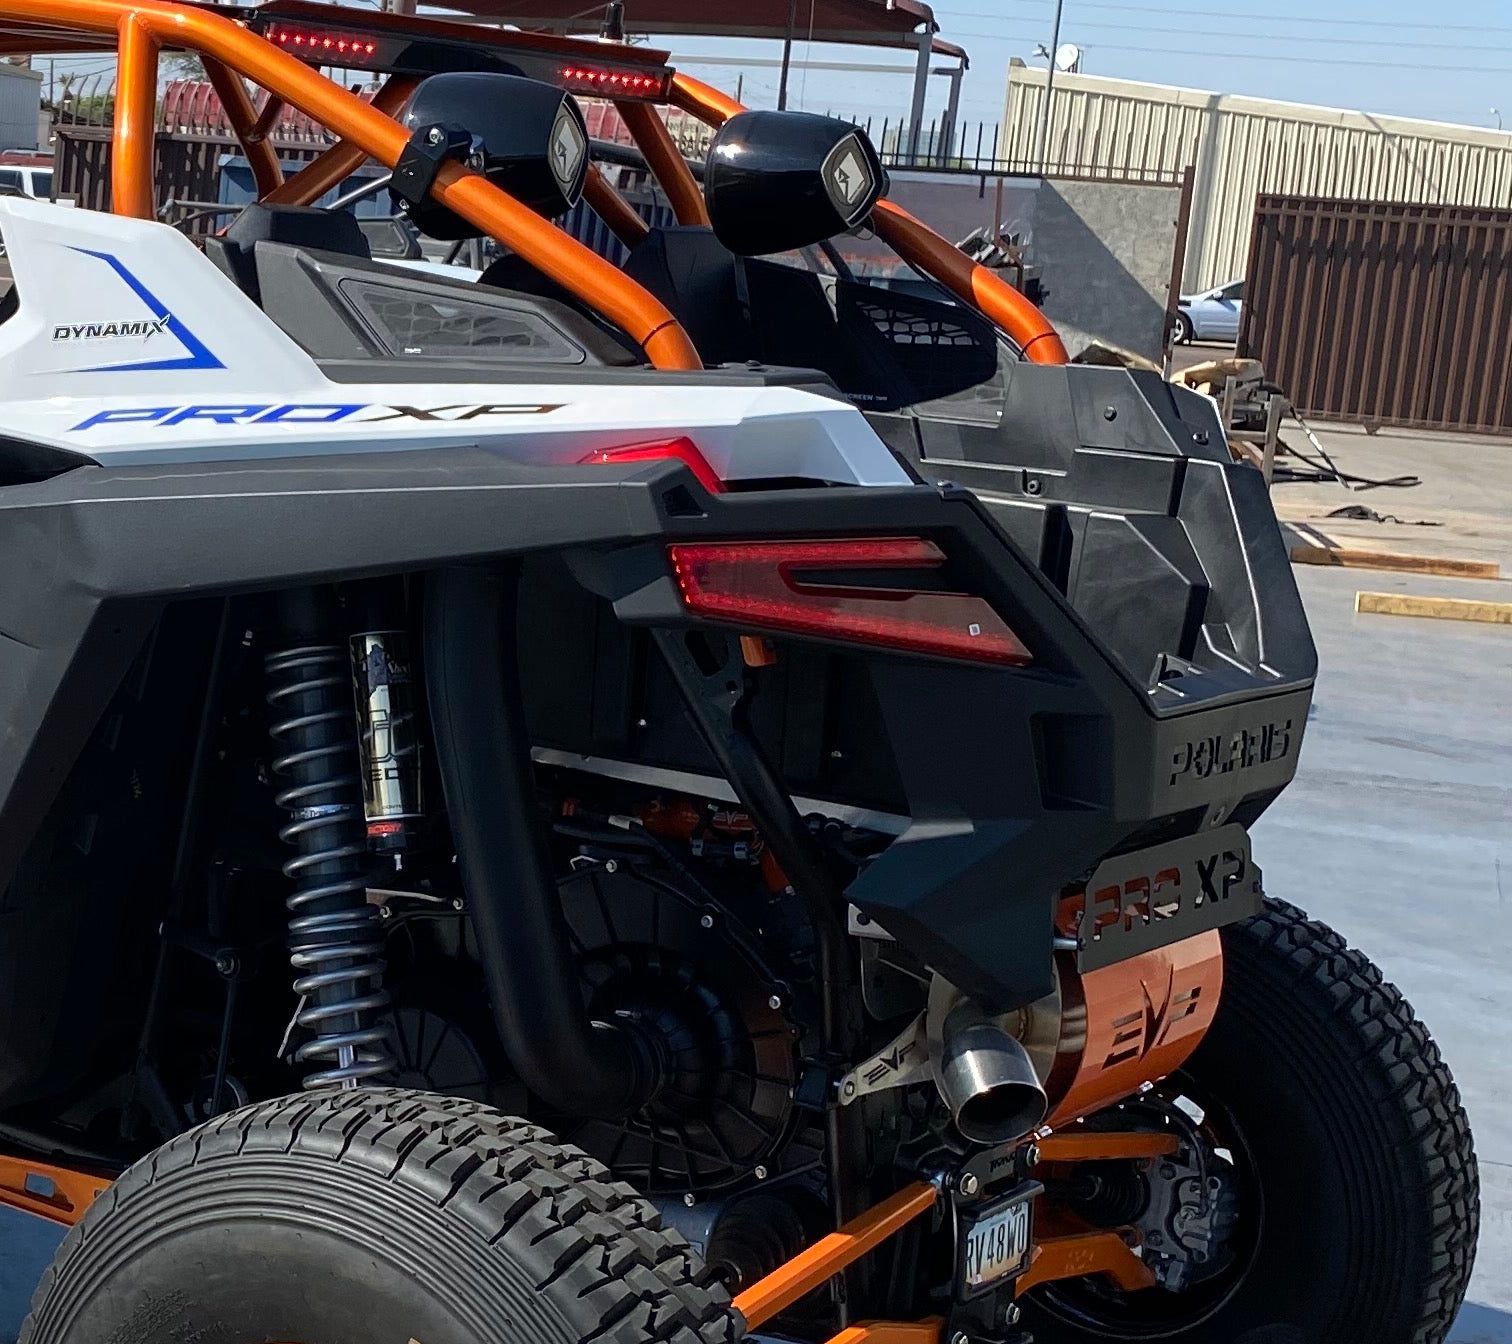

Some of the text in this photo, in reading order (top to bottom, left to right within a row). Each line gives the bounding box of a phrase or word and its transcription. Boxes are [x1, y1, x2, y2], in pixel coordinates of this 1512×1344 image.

[52, 312, 172, 343] DYNAMIX
[1168, 719, 1292, 786] POLARIS
[1092, 847, 1245, 942] PRO XP
